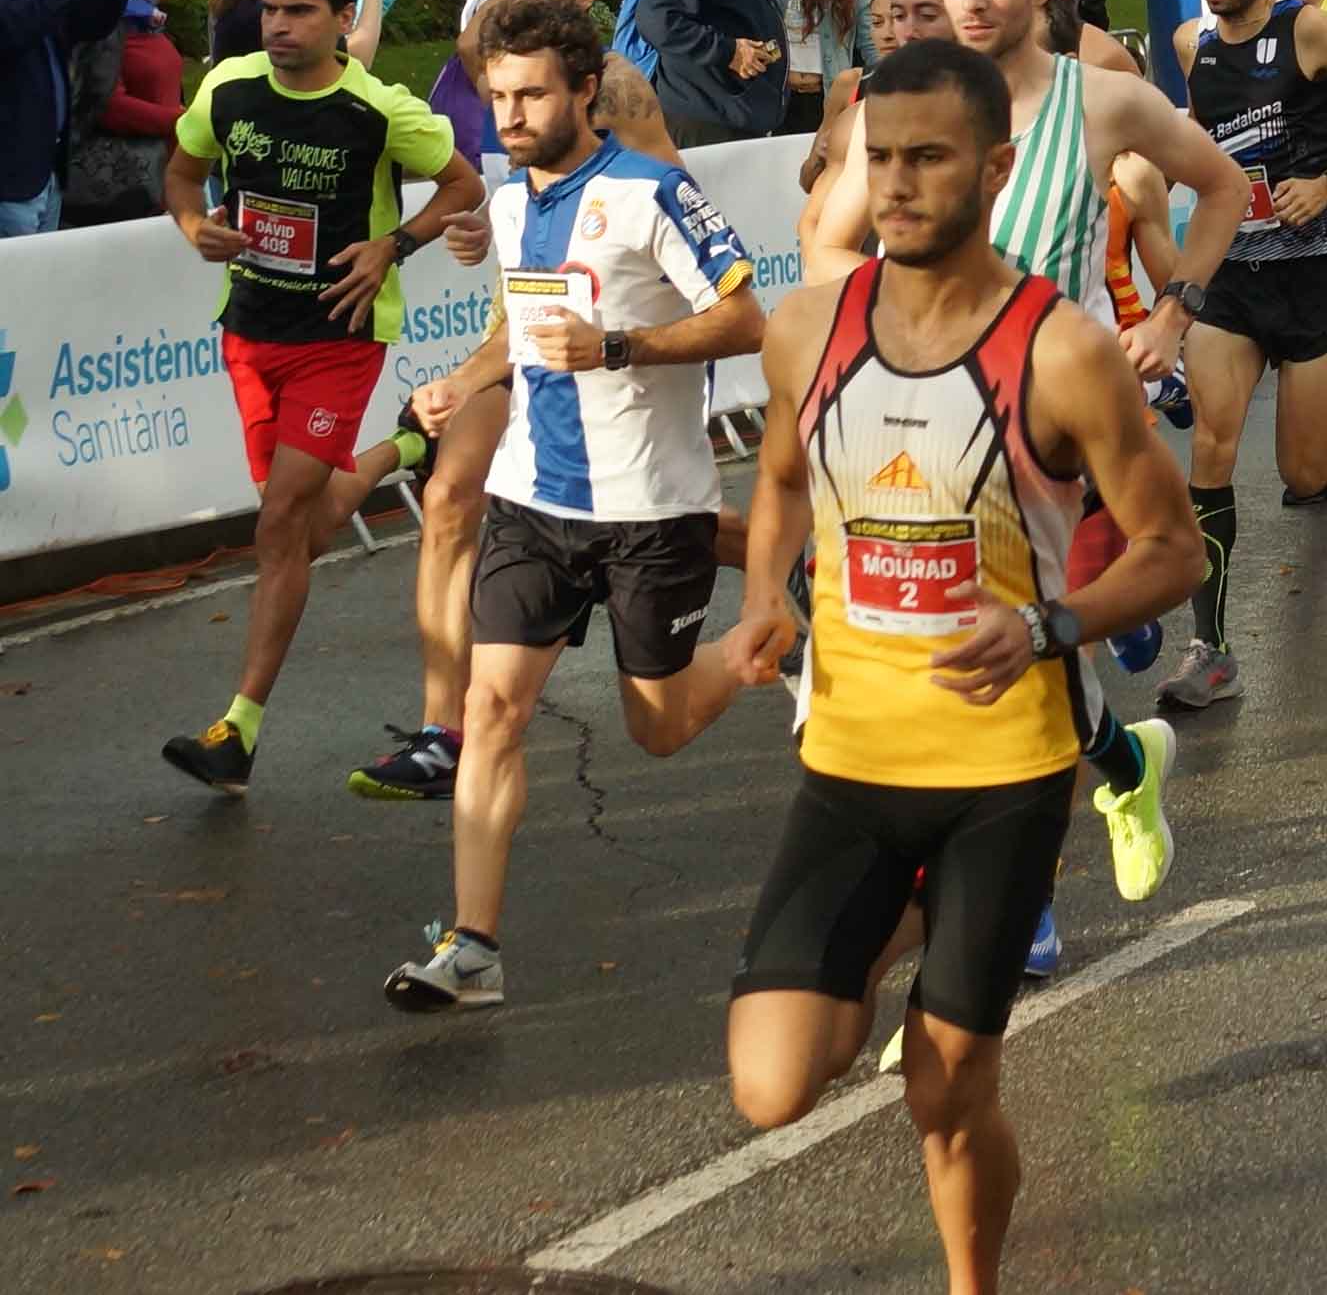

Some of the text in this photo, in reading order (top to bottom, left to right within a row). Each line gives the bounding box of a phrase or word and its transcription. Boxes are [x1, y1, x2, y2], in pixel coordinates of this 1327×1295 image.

[1216, 100, 1283, 140] Badalona
[255, 220, 296, 240] DAVID
[258, 235, 290, 255] 408
[400, 284, 494, 344] Assistè
[50, 320, 230, 399] Assistènci
[51, 394, 189, 466] Sanitària
[862, 553, 957, 580] MOURAD
[898, 580, 919, 609] 2
